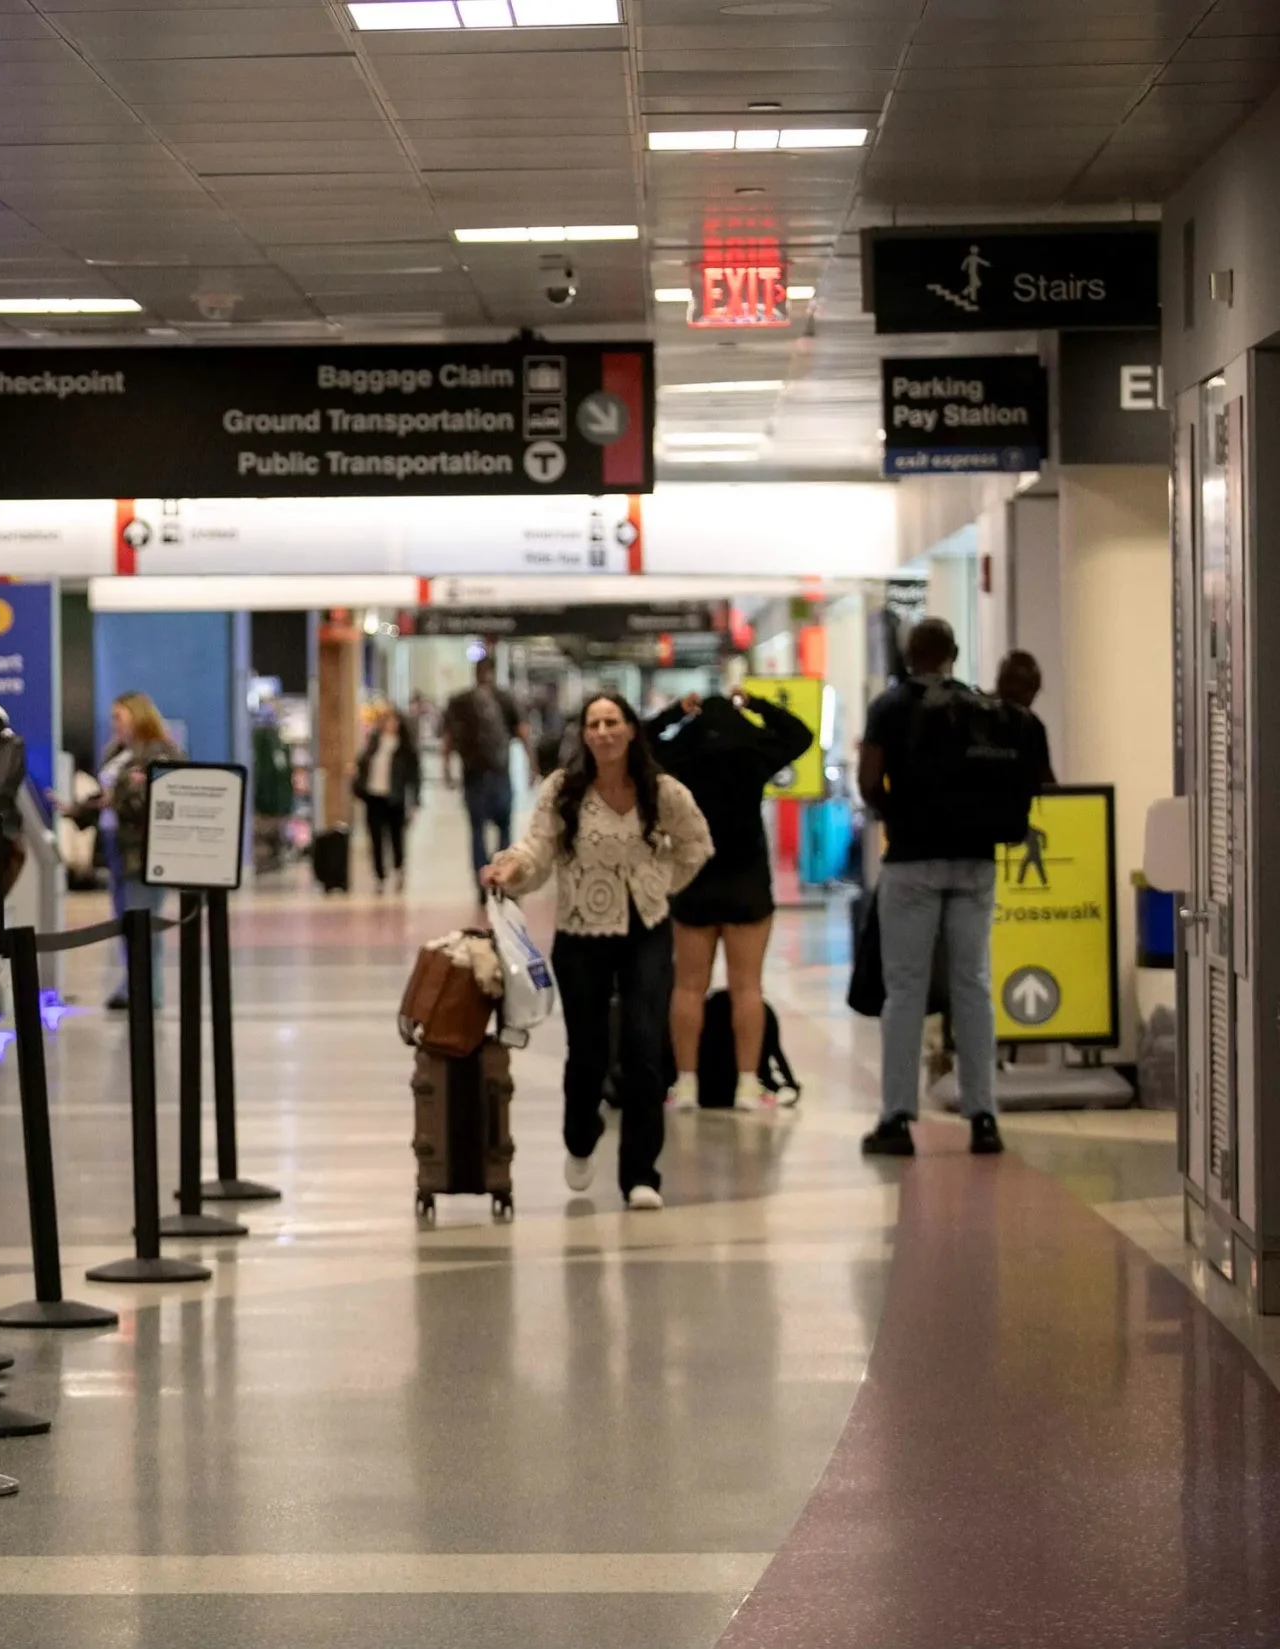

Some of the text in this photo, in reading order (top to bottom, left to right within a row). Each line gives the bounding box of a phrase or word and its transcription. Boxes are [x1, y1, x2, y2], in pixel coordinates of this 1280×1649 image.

[703, 266, 782, 321] EXIT
[1012, 272, 1107, 302] Stairs
[317, 363, 515, 394] Baggage Claim
[891, 376, 984, 402] Parking
[222, 408, 516, 438] Ground Transportation
[892, 403, 1028, 431] Pay Station
[237, 450, 320, 476] Public
[324, 449, 514, 480] Transportation
